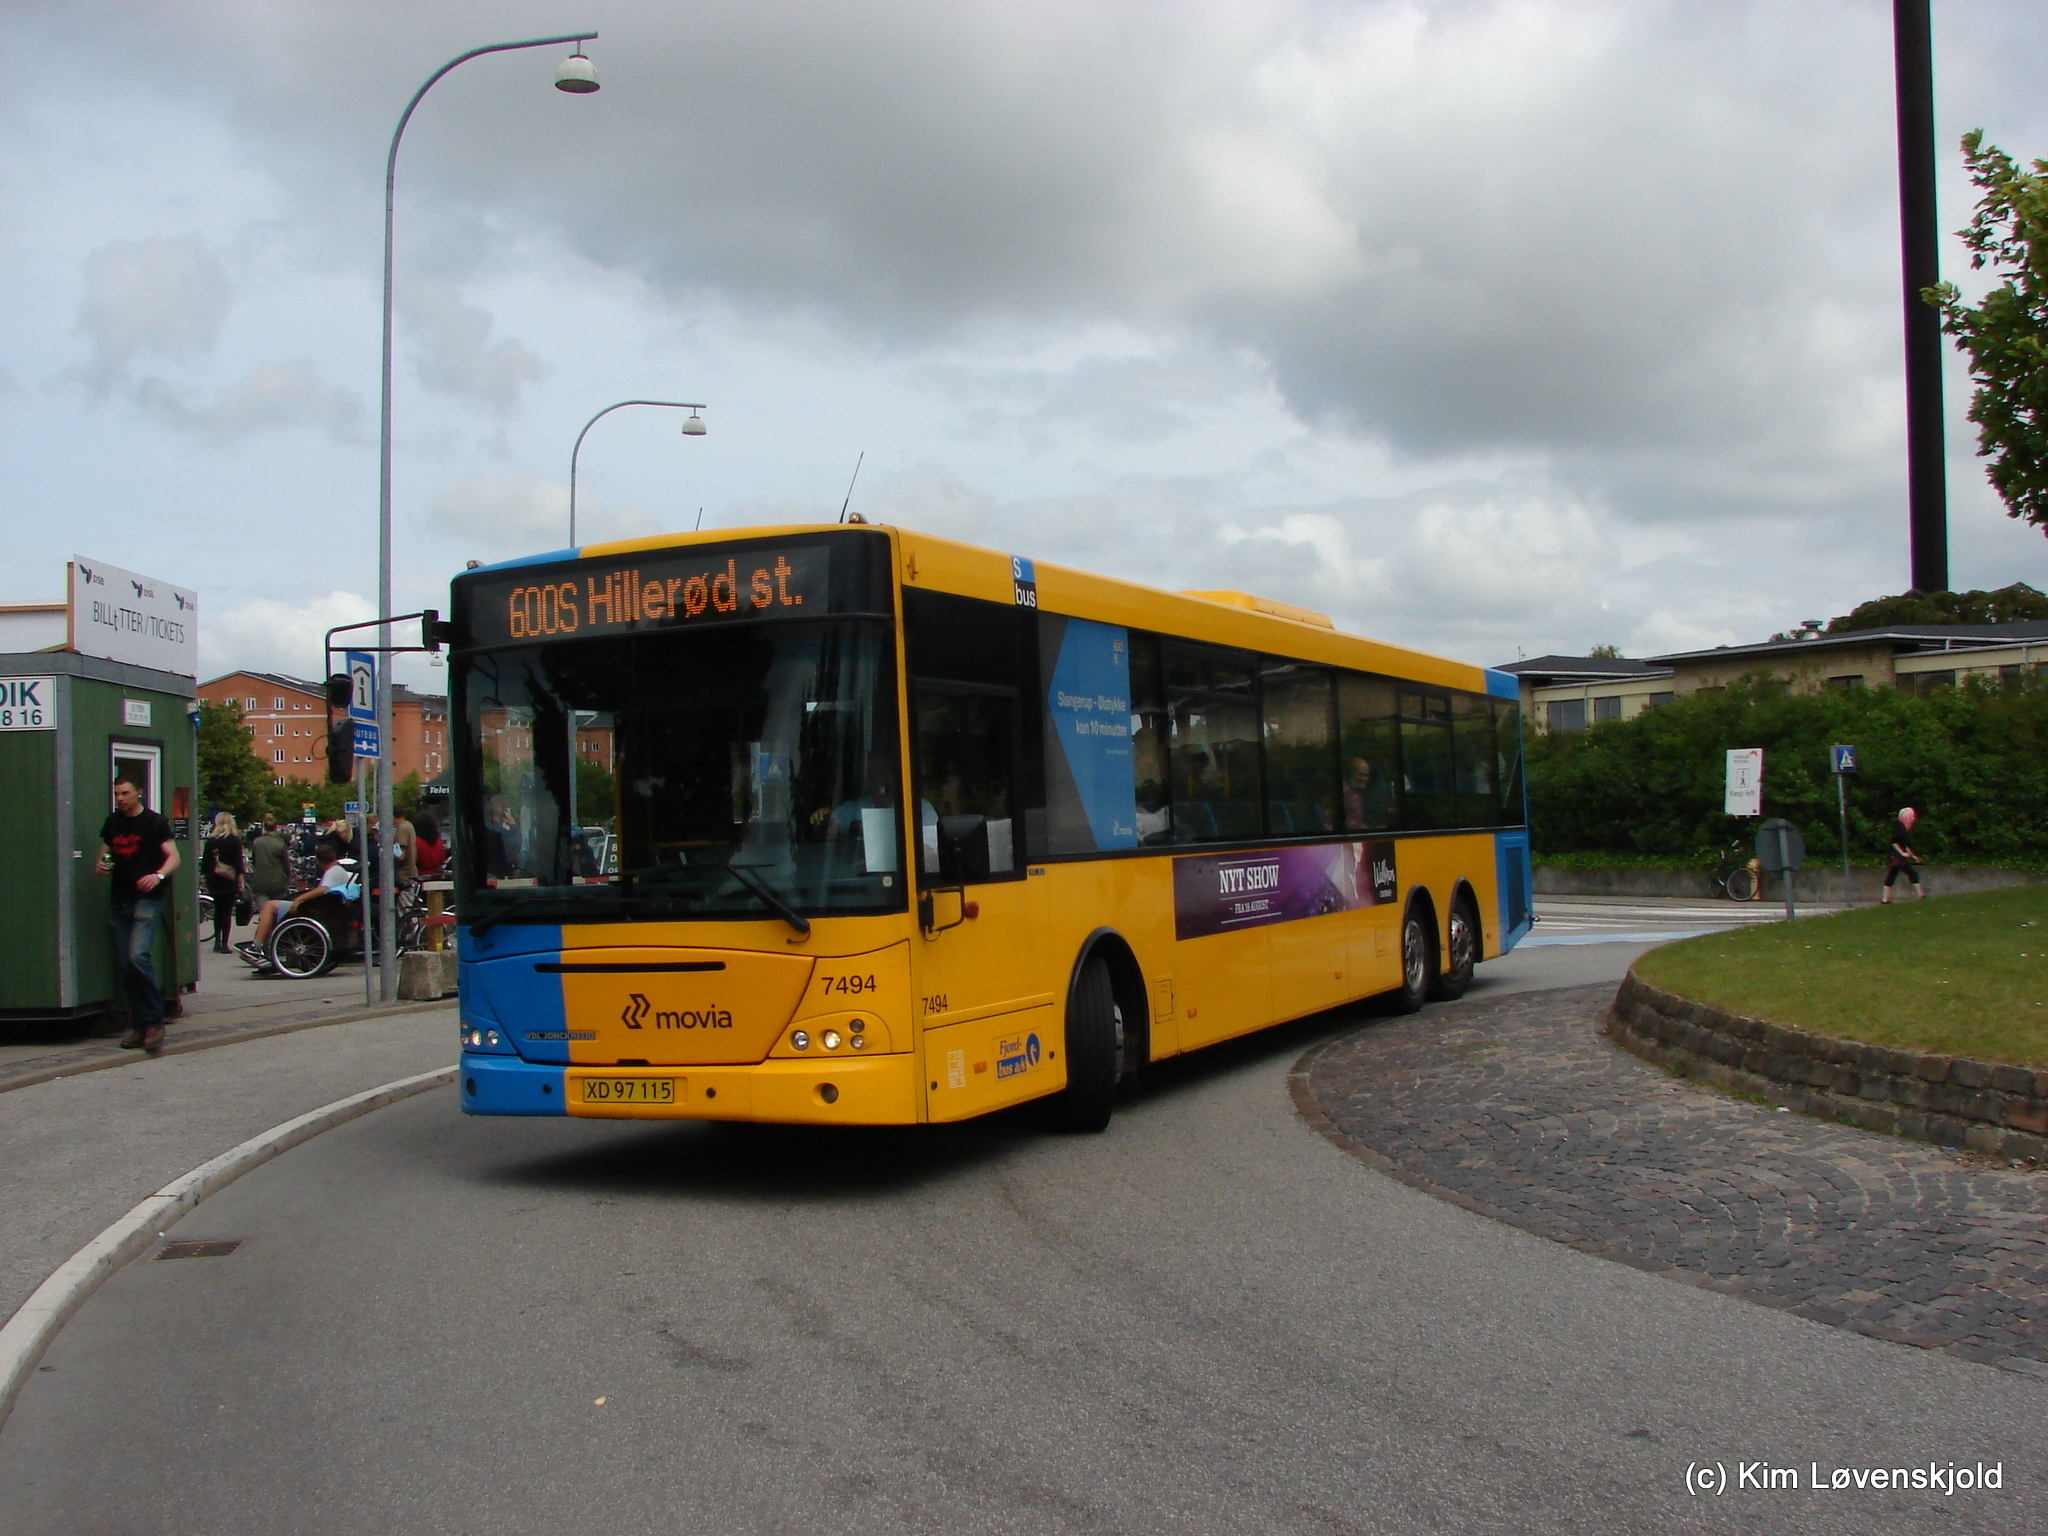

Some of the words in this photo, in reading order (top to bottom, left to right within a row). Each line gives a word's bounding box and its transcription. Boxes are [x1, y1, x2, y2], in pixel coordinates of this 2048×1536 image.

[1013, 558, 1022, 579] S
[93, 575, 104, 586] DSB
[510, 582, 578, 638] 600S
[588, 559, 736, 625] Hillerød
[751, 556, 802, 609] st.
[1015, 583, 1036, 607] bus
[150, 616, 185, 644] TICKETS
[1058, 691, 1093, 712] Slangerup
[20, 709, 43, 726] 16
[1076, 720, 1090, 735] kun
[1091, 721, 1099, 735] 10
[1100, 722, 1127, 737] minutter
[1219, 868, 1244, 894] NYT
[1246, 864, 1279, 889] SHOW
[821, 974, 877, 995] 7494
[922, 994, 948, 1015] 7494
[656, 1004, 733, 1029] movia
[999, 1062, 1013, 1077] bus
[586, 1082, 610, 1099] XD
[615, 1081, 635, 1099] 97
[641, 1080, 671, 1098] 115
